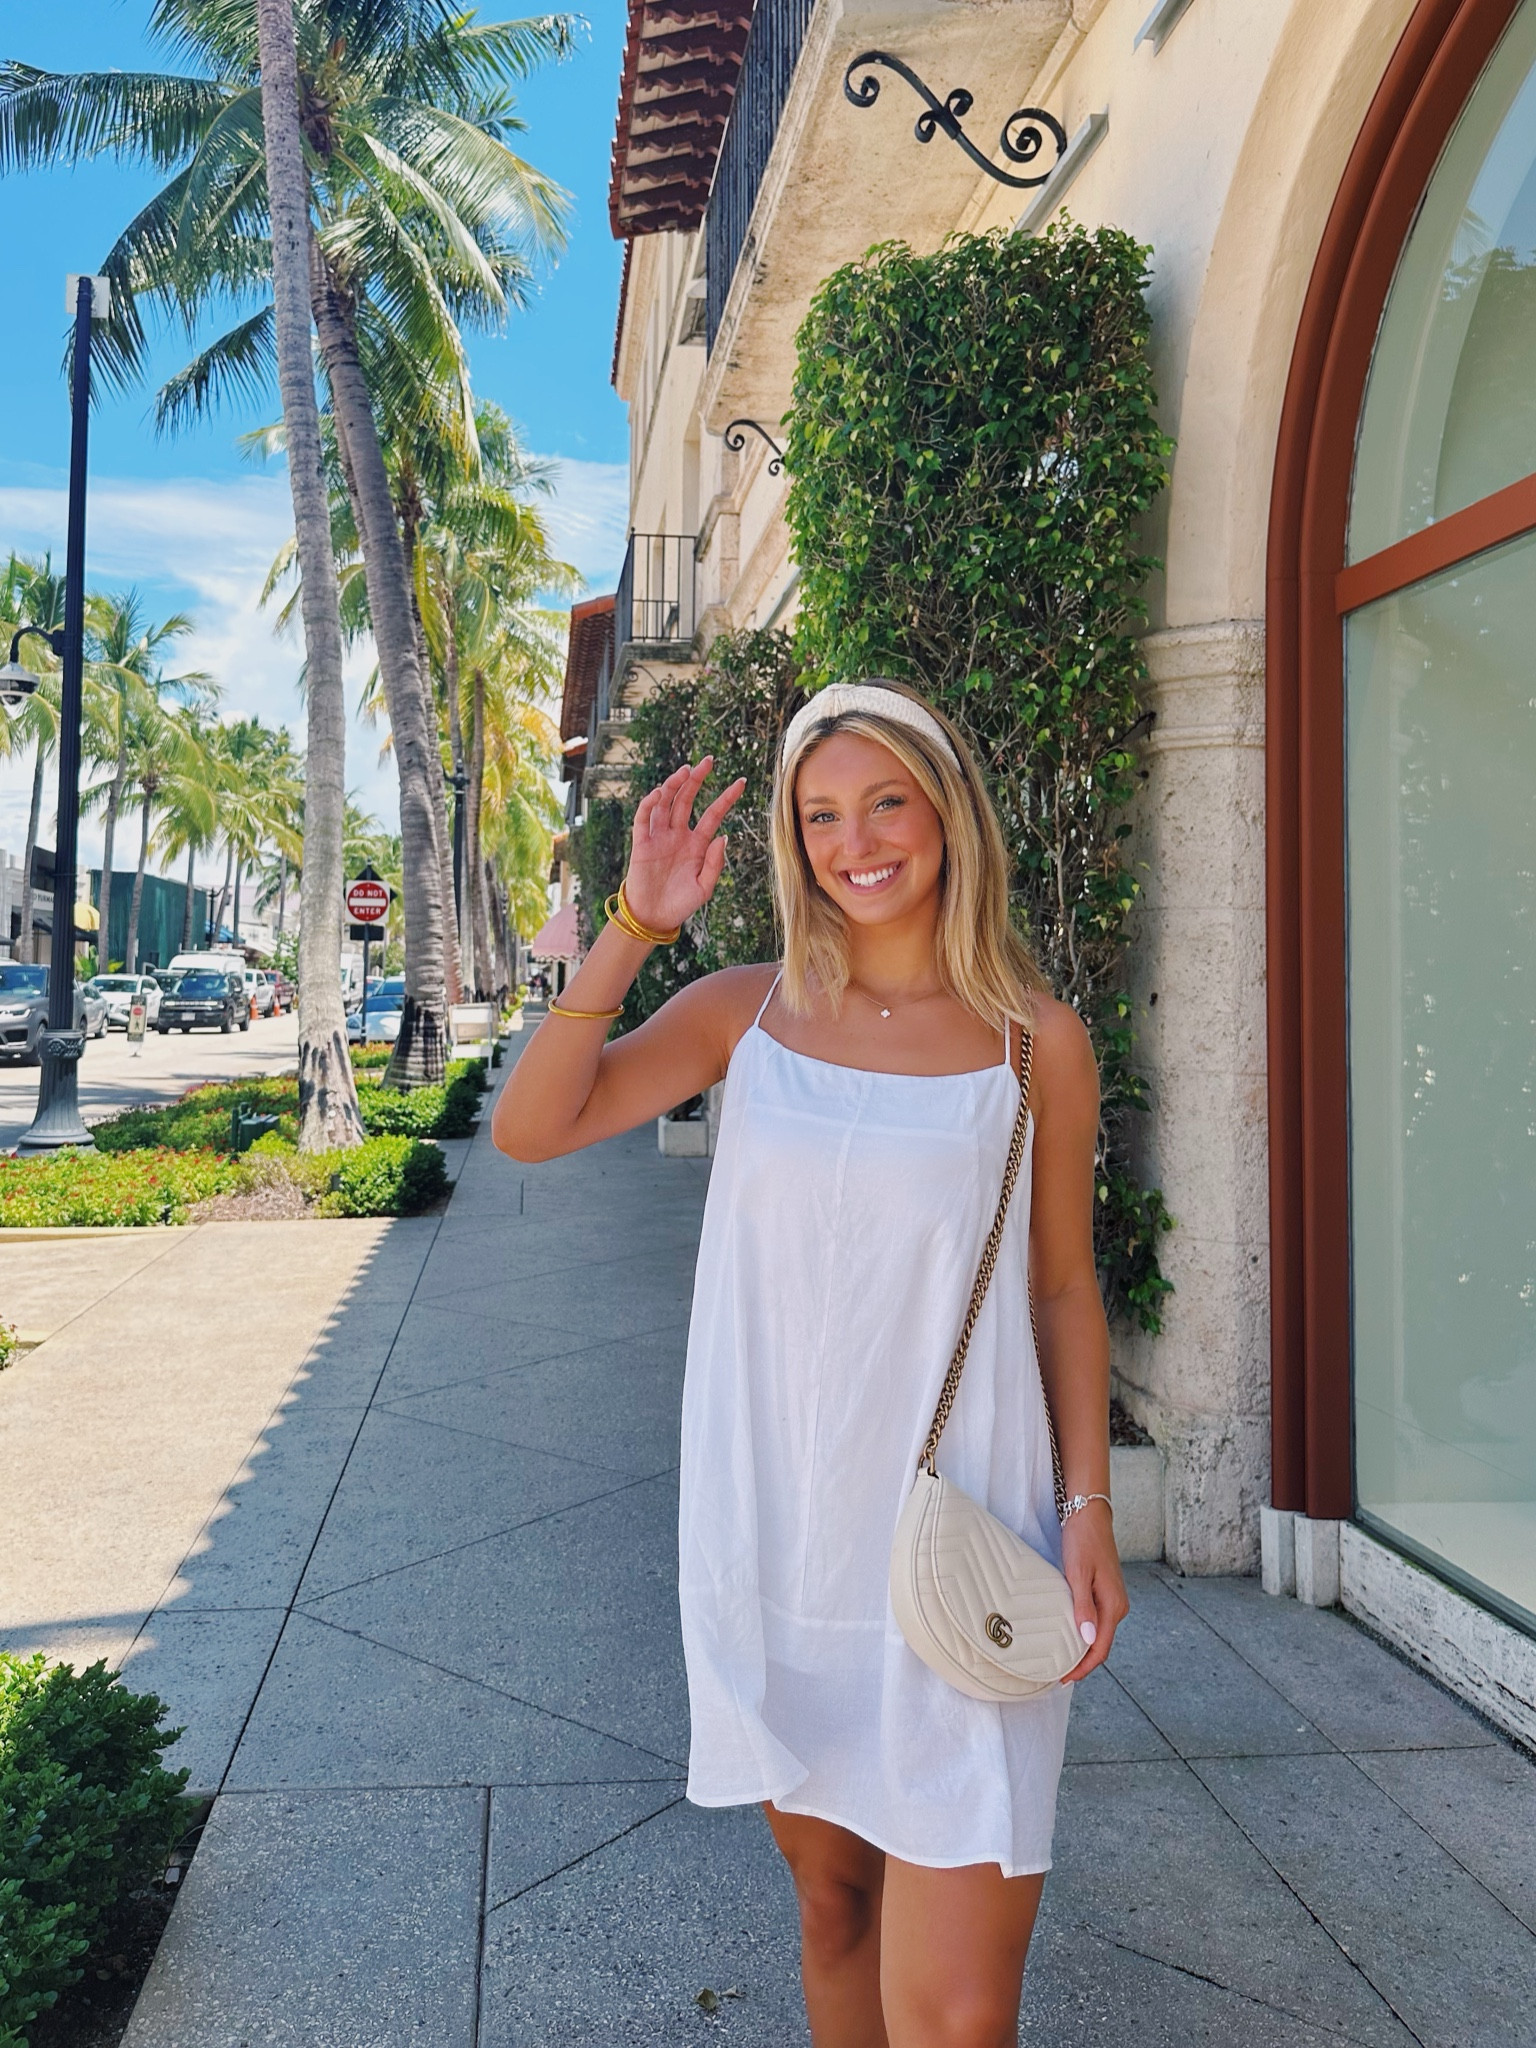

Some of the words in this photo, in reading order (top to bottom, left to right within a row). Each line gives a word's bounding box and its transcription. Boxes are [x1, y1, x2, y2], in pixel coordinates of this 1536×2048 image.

[353, 889, 364, 897] DO
[367, 889, 383, 897] NOT
[353, 907, 381, 915] ENTER
